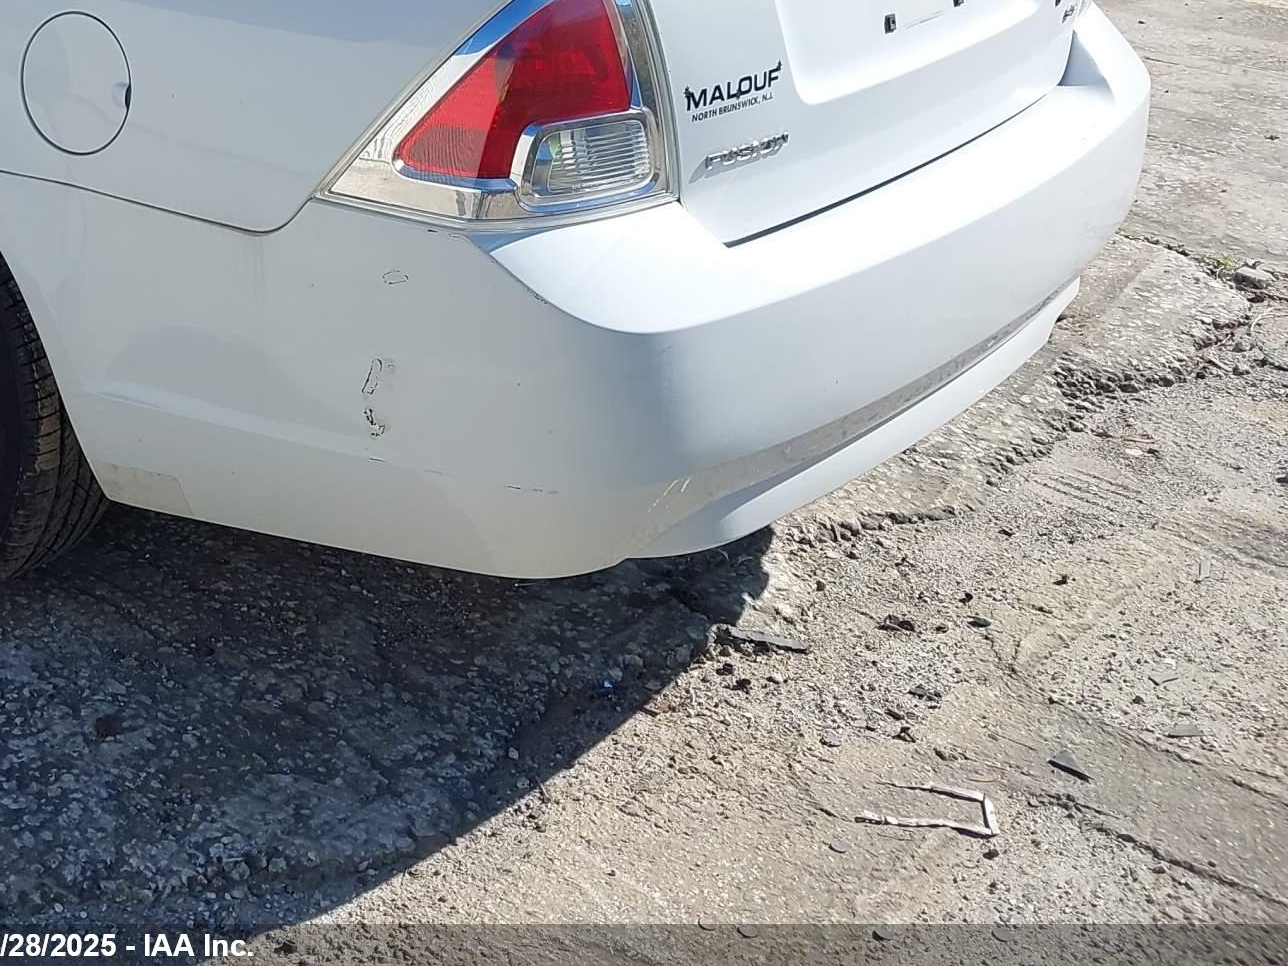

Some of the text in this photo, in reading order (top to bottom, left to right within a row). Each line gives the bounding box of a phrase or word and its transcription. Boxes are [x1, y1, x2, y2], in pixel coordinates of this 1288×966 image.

[684, 60, 782, 112] MALOUF
[692, 108, 717, 123] NORTH
[718, 96, 761, 115] BRUNSWICK,
